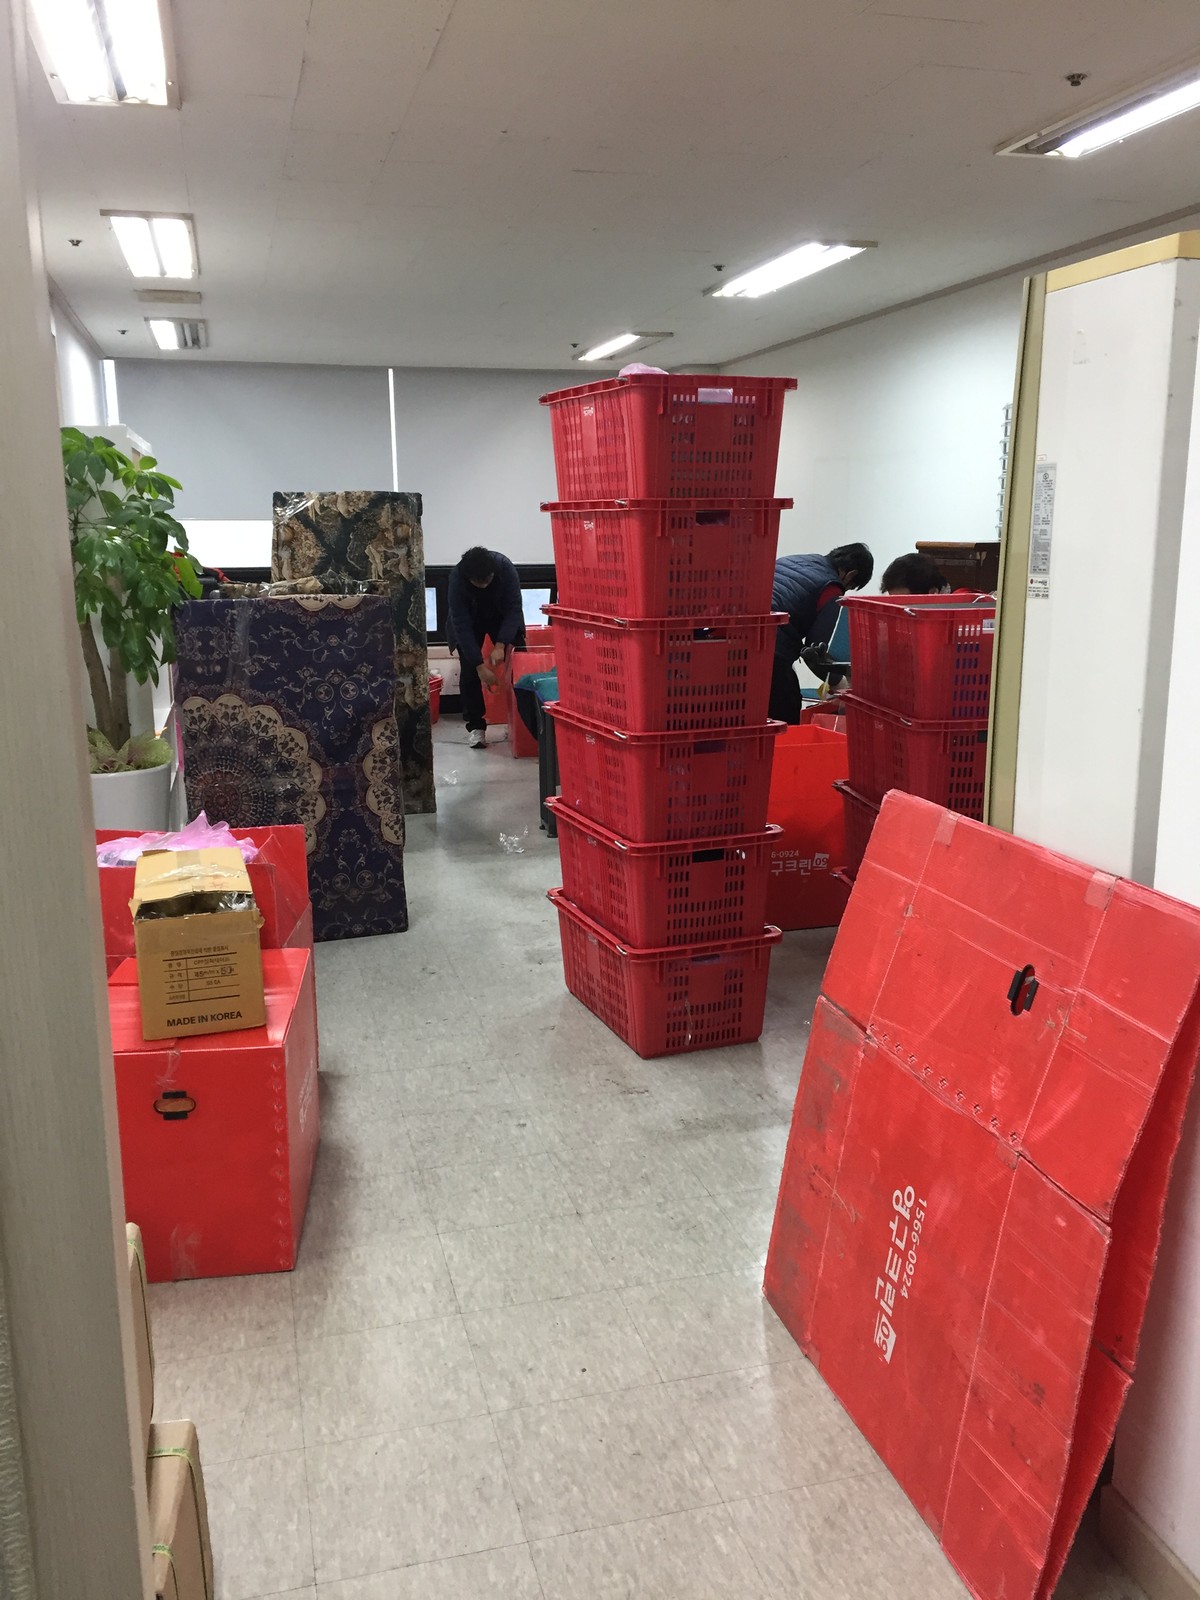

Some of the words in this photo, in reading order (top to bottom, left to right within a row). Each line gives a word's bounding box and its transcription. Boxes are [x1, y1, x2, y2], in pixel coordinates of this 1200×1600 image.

[167, 1016, 196, 1027] MADE
[197, 1014, 208, 1023] IN
[210, 1010, 242, 1022] KOREA
[875, 1186, 915, 1317] 영구크린
[901, 1197, 927, 1299] 1566-0924
